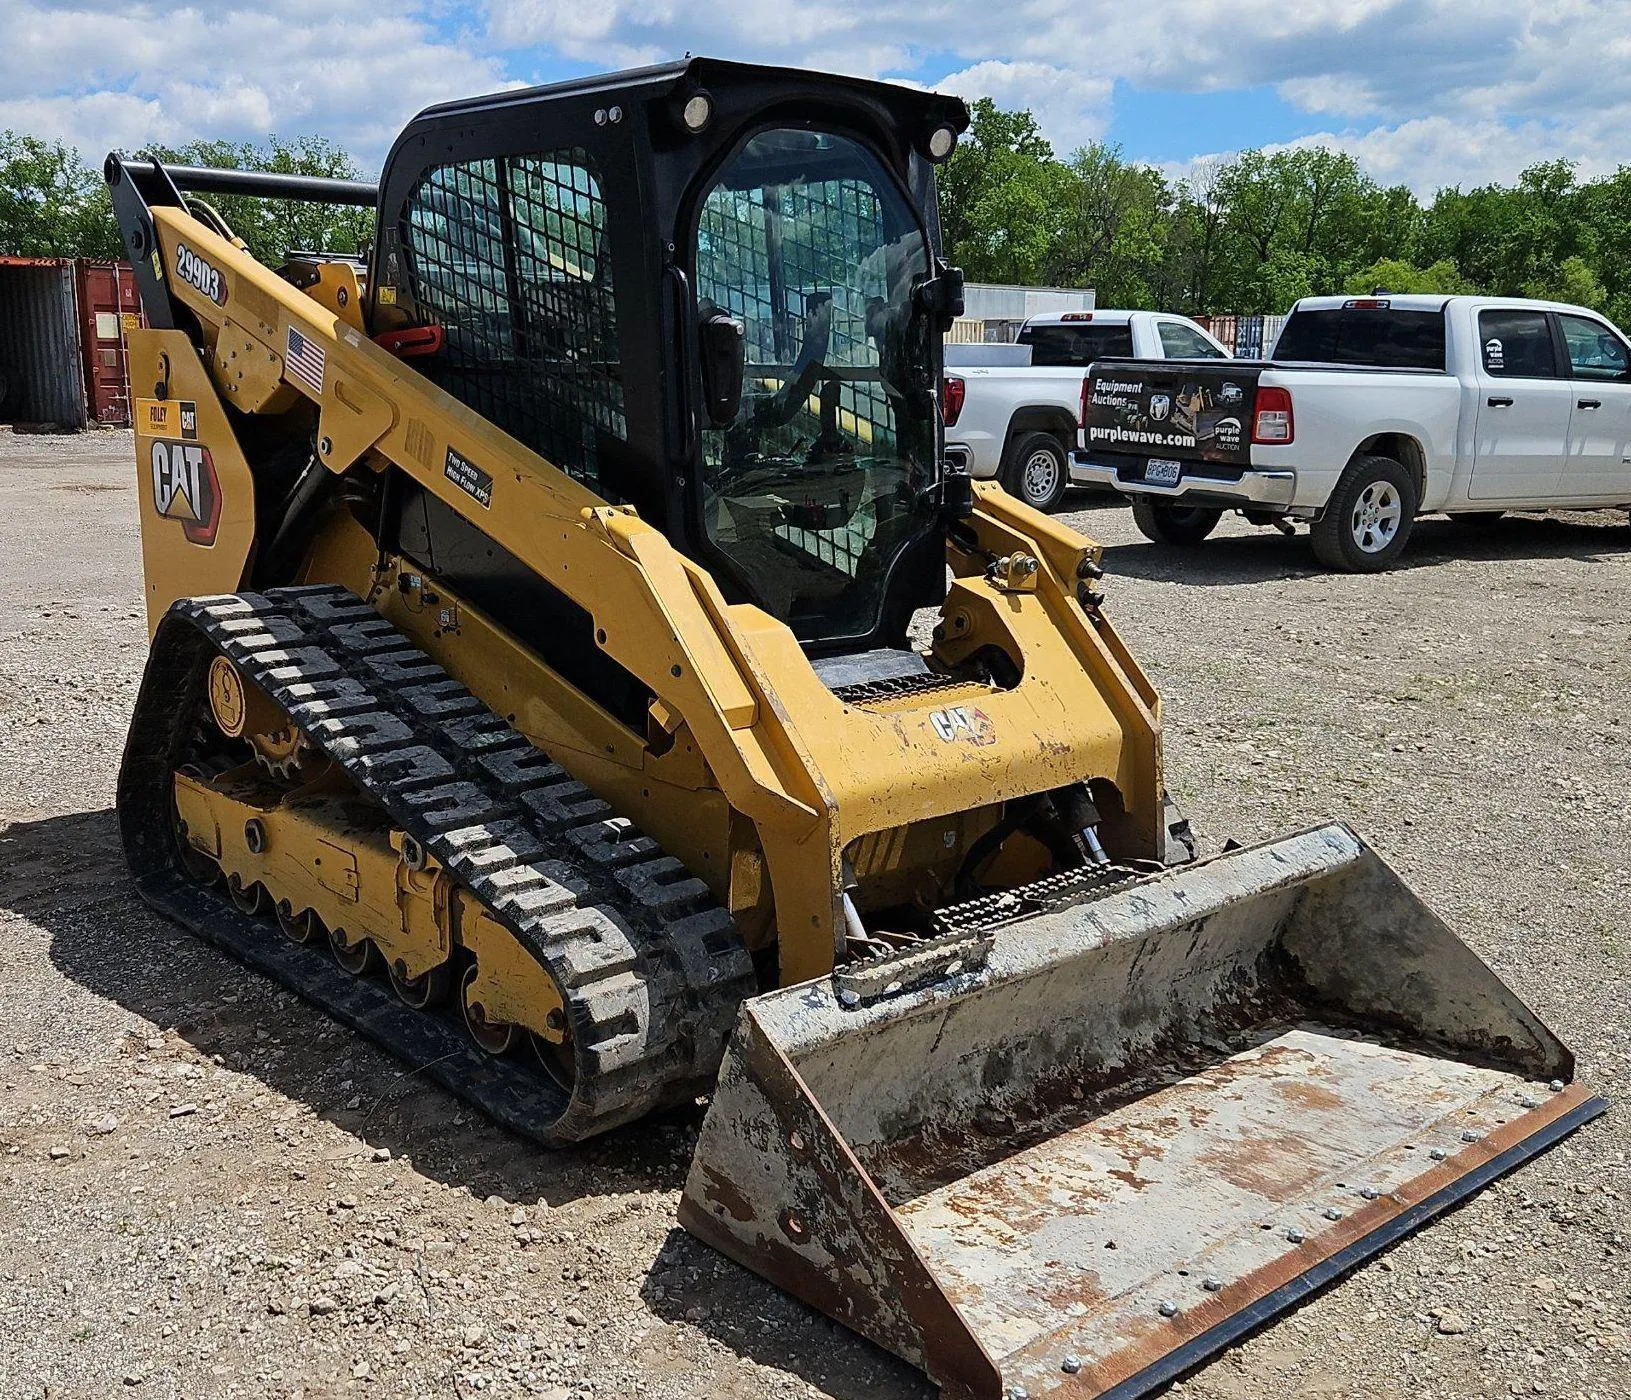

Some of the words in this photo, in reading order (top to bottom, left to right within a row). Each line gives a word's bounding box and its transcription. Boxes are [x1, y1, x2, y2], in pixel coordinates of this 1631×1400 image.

[177, 245, 219, 301] 299D3
[1095, 378, 1143, 394] Equipment
[1091, 393, 1128, 406] Auctions
[150, 406, 167, 422] FOLEY
[181, 411, 195, 430] CAT
[1090, 426, 1196, 448] purplewave.com
[1215, 425, 1240, 436] purple
[1216, 443, 1240, 451] AUCTION
[152, 441, 202, 521] CAT
[475, 487, 489, 503] XPS
